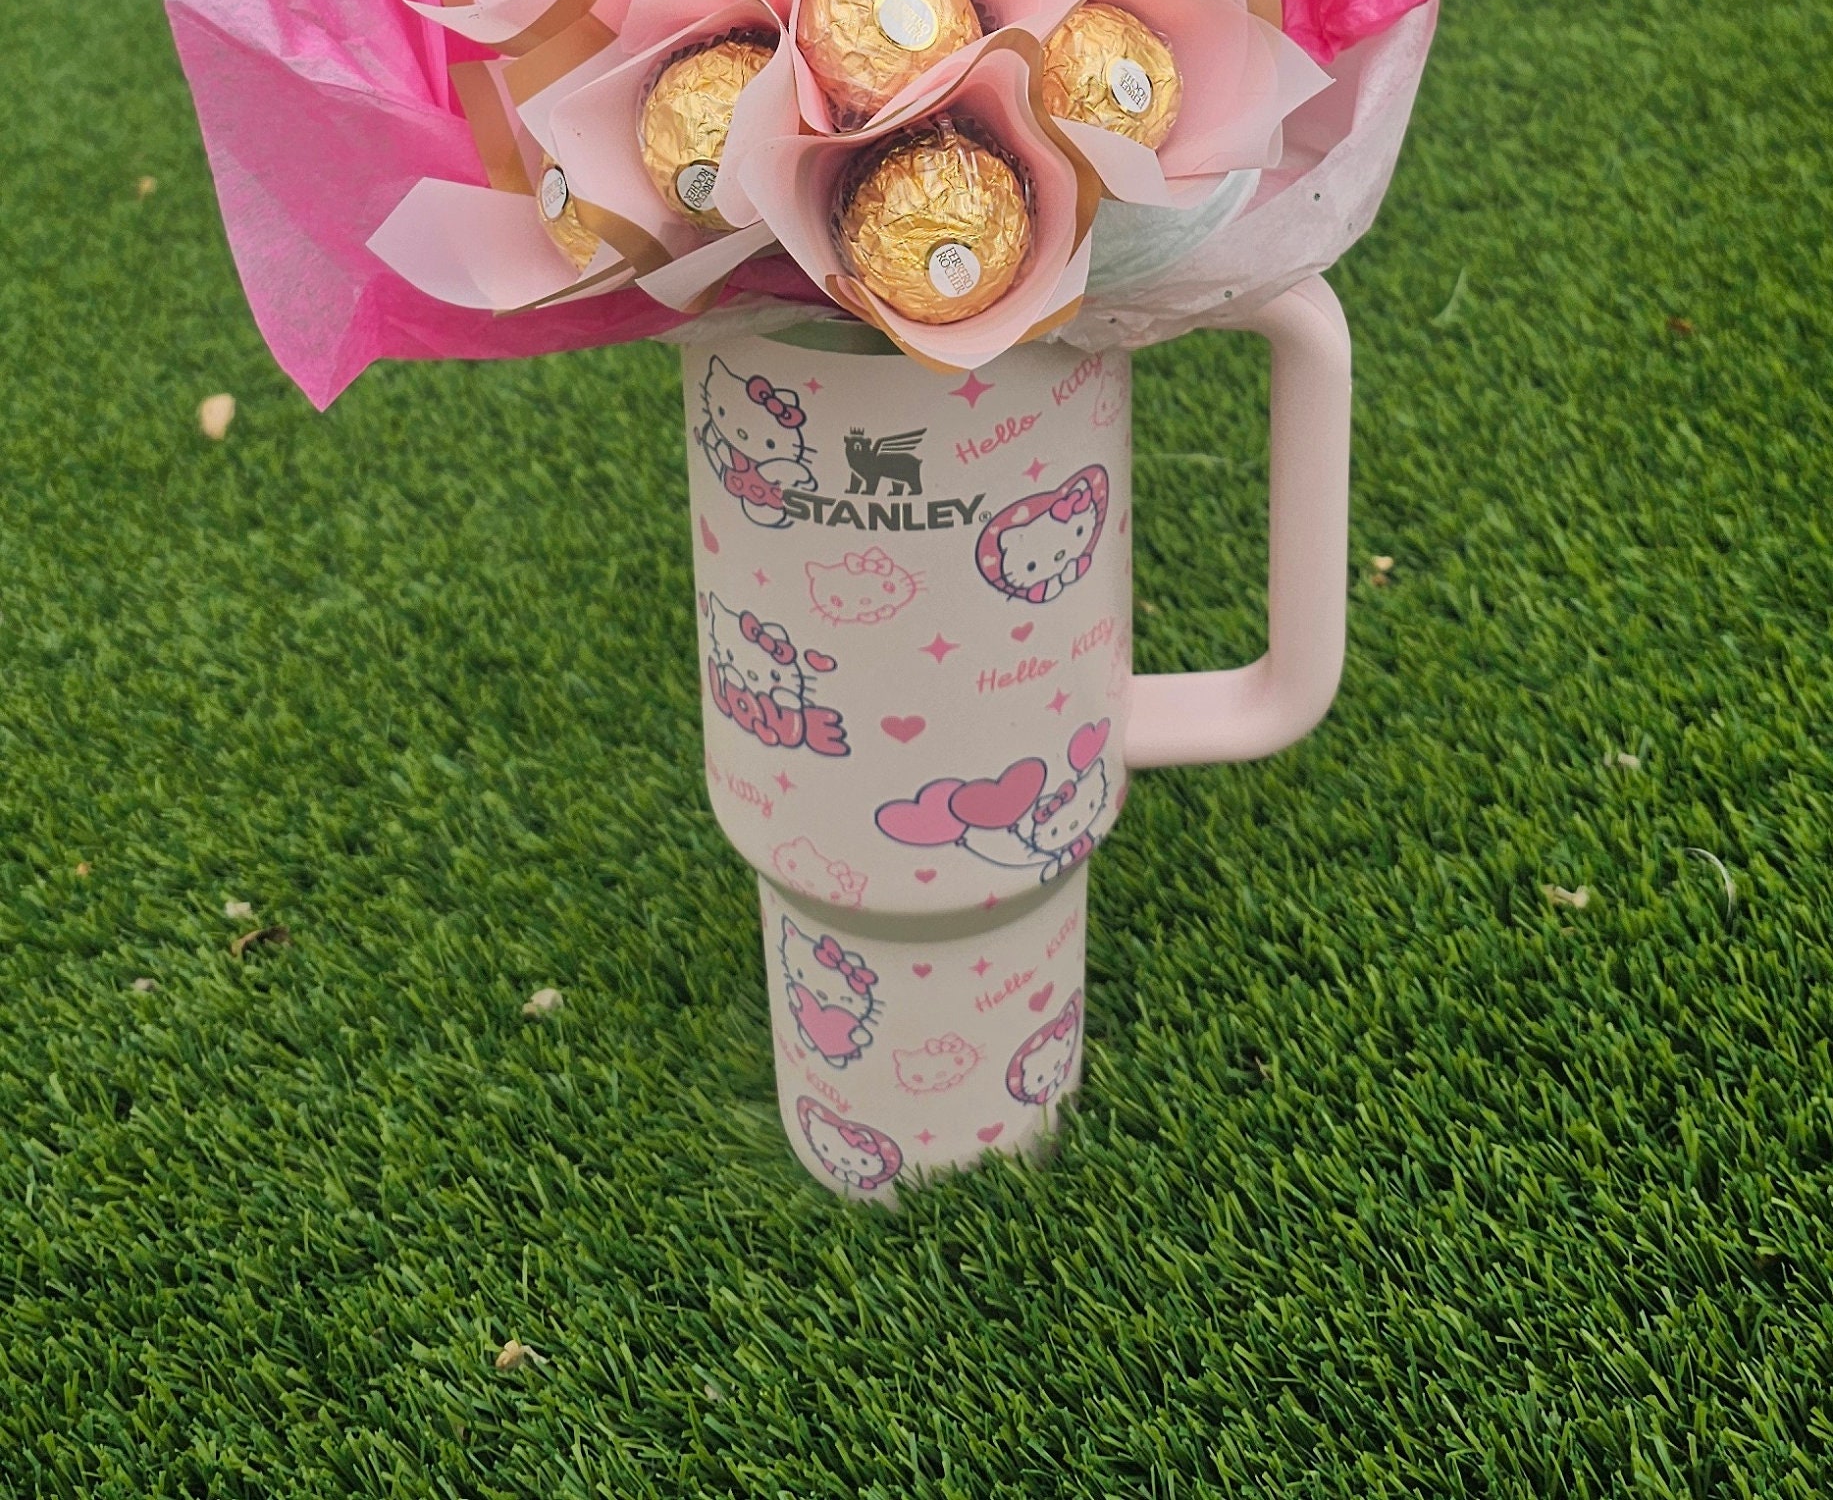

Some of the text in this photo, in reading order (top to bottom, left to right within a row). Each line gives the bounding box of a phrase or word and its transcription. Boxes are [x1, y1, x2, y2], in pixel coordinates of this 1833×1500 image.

[684, 168, 710, 201] ROCHER
[936, 251, 965, 294] ROCHER
[945, 246, 974, 289] FERRERO
[955, 351, 1104, 465] Hello Kitty
[782, 489, 986, 532] STANLEY
[976, 616, 1115, 694] Hello Kitty
[708, 656, 852, 757] LOVE
[974, 964, 1038, 1013] Hello
